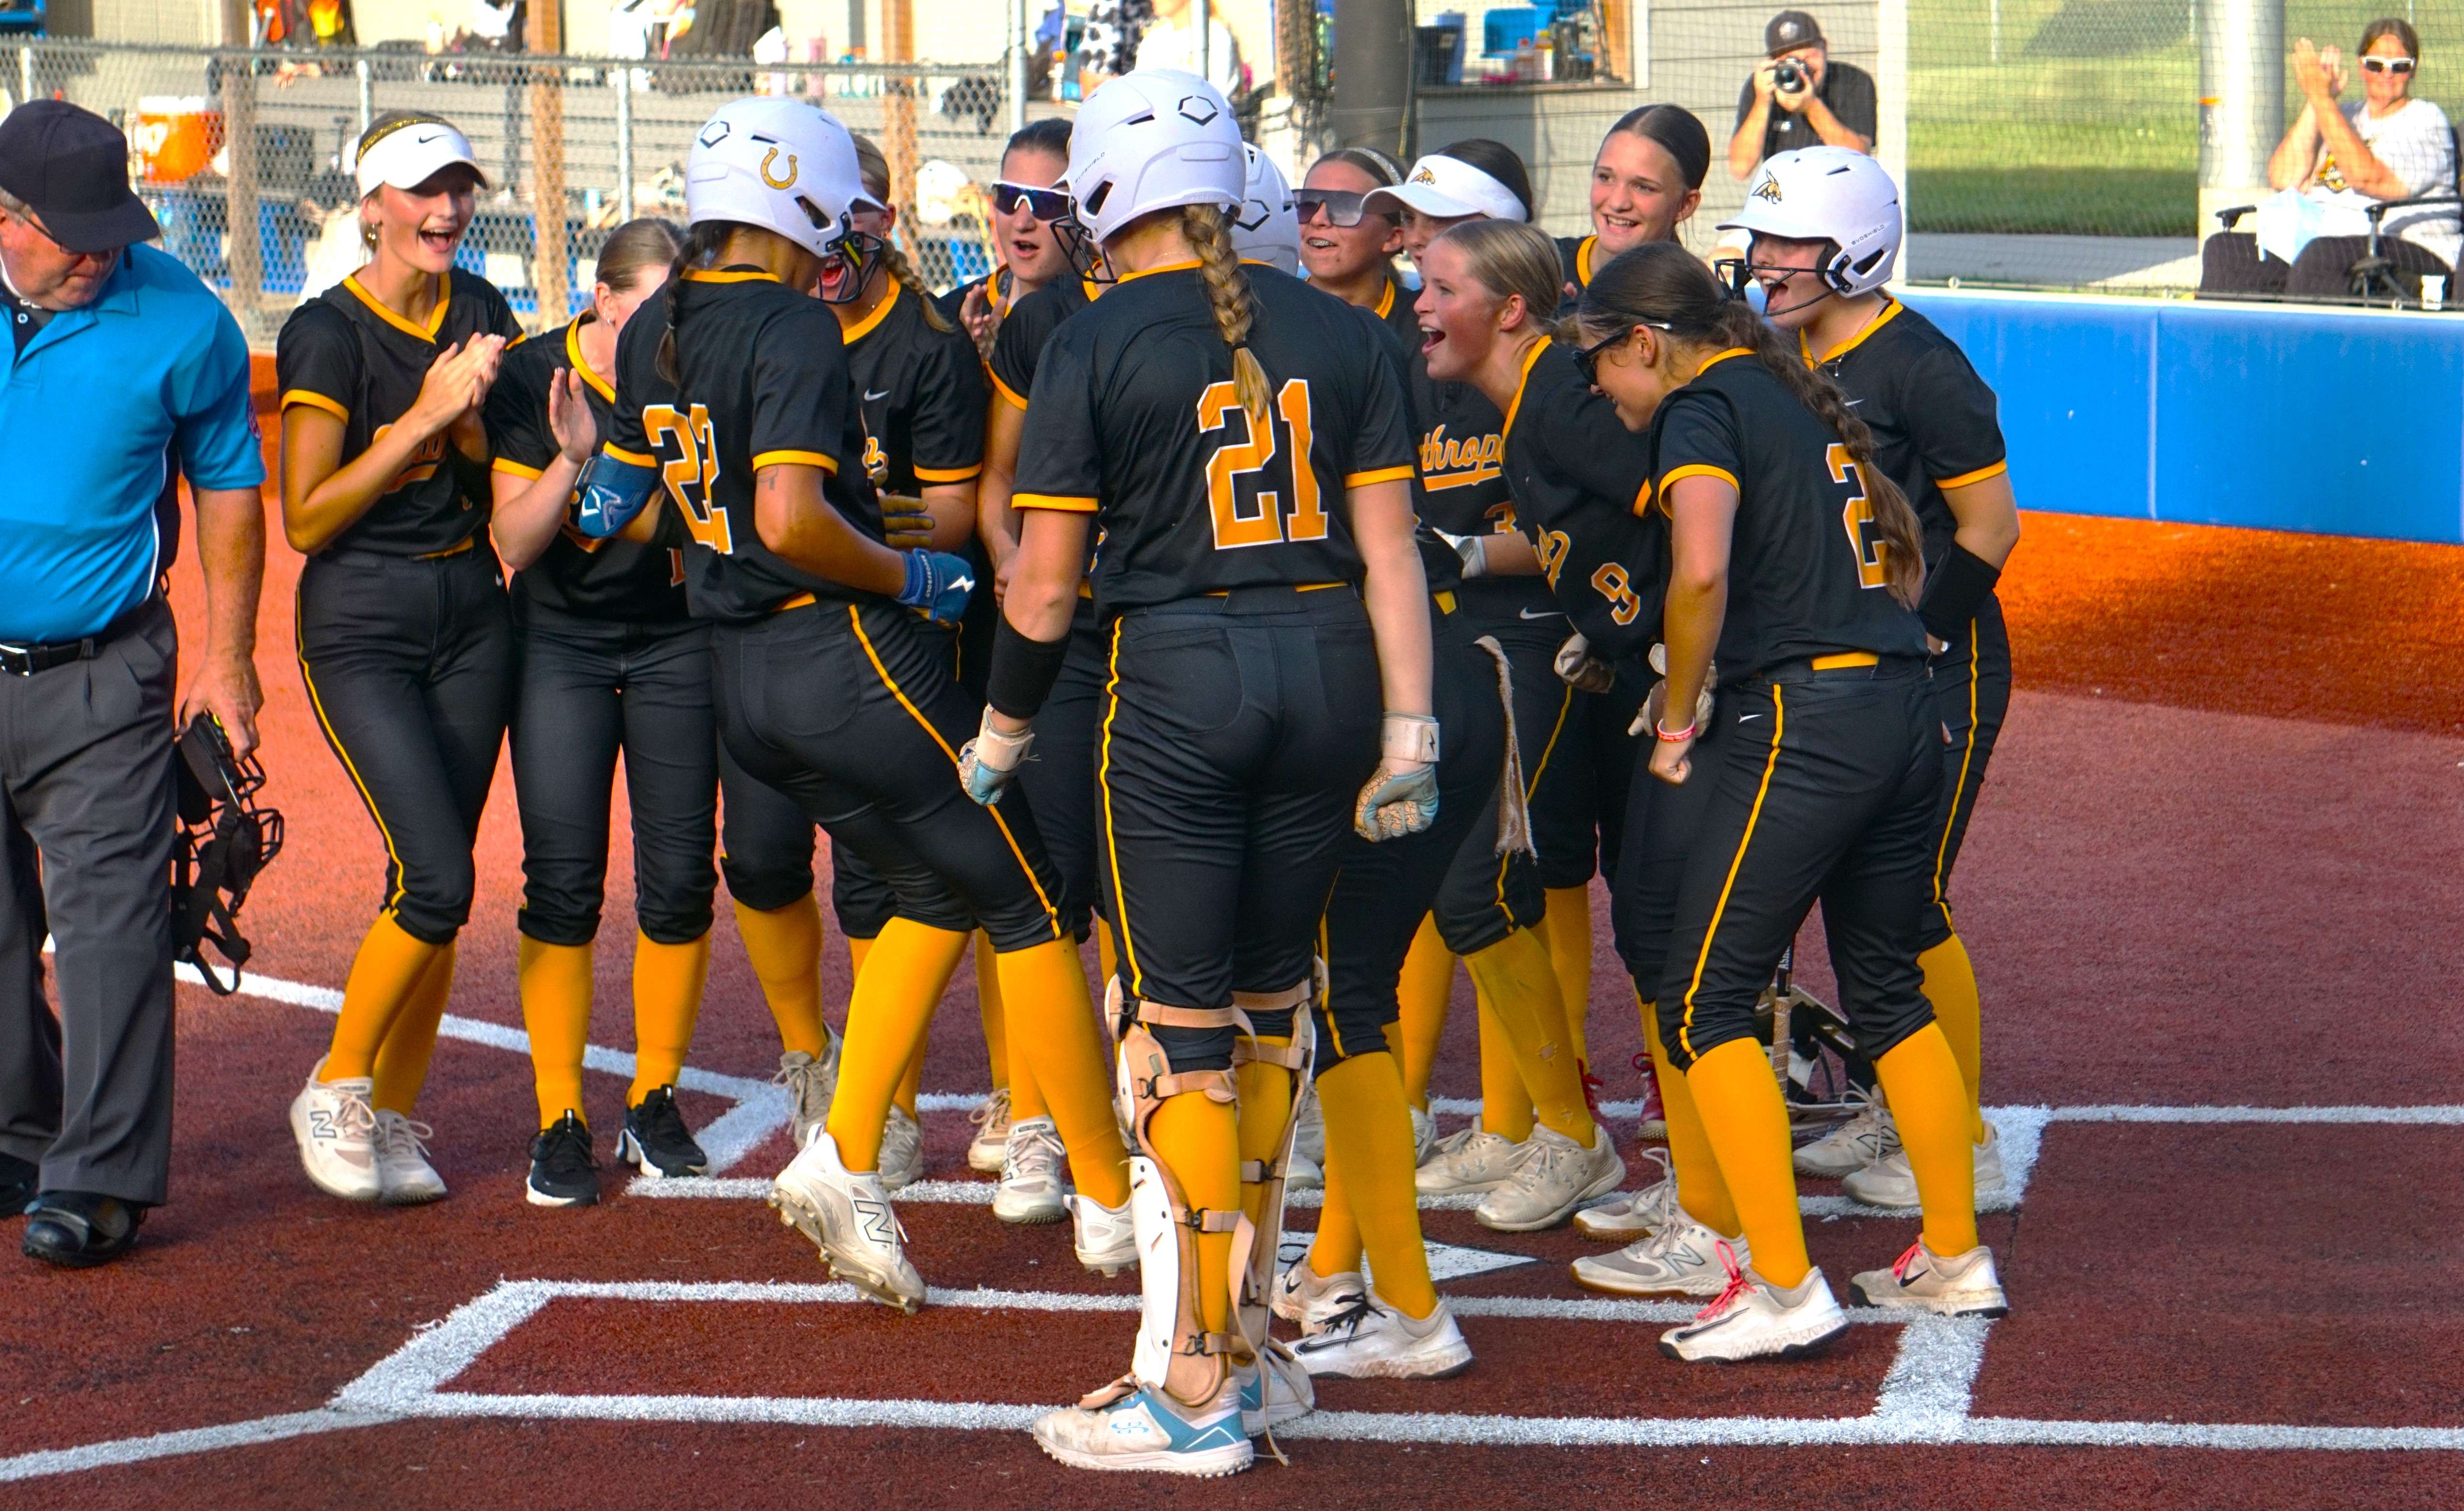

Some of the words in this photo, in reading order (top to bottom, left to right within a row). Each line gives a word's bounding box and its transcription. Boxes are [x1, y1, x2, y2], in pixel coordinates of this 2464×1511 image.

[642, 404, 733, 555] 22
[1197, 378, 1328, 550] 21
[1591, 562, 1640, 626] 9
